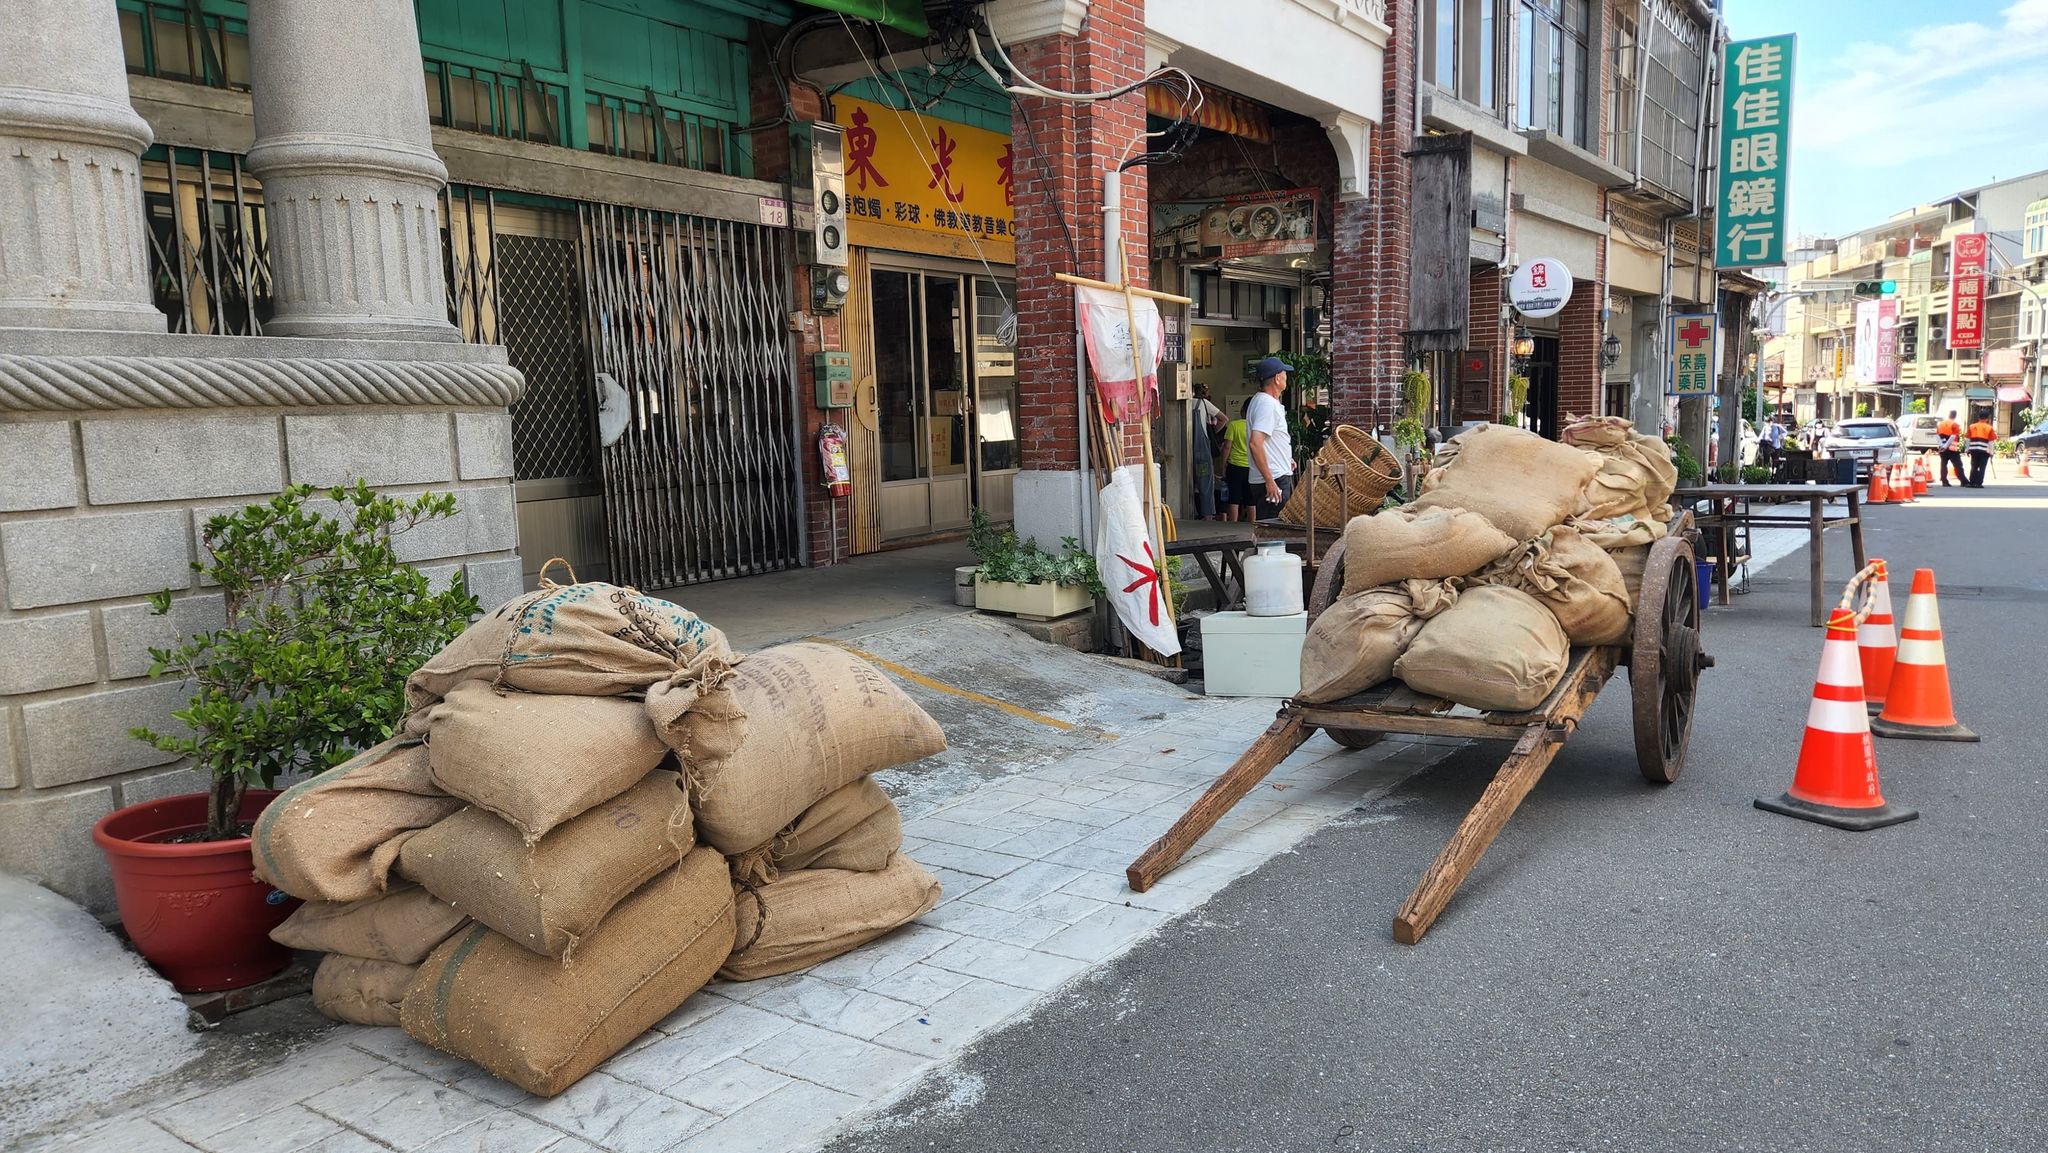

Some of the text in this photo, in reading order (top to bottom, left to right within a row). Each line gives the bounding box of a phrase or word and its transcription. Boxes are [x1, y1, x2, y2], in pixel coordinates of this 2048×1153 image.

[1726, 43, 1782, 261] 佳佳眼鏡行
[769, 210, 783, 224] 18
[1956, 261, 1980, 330] 元福西點
[1678, 373, 1706, 390] 藥局
